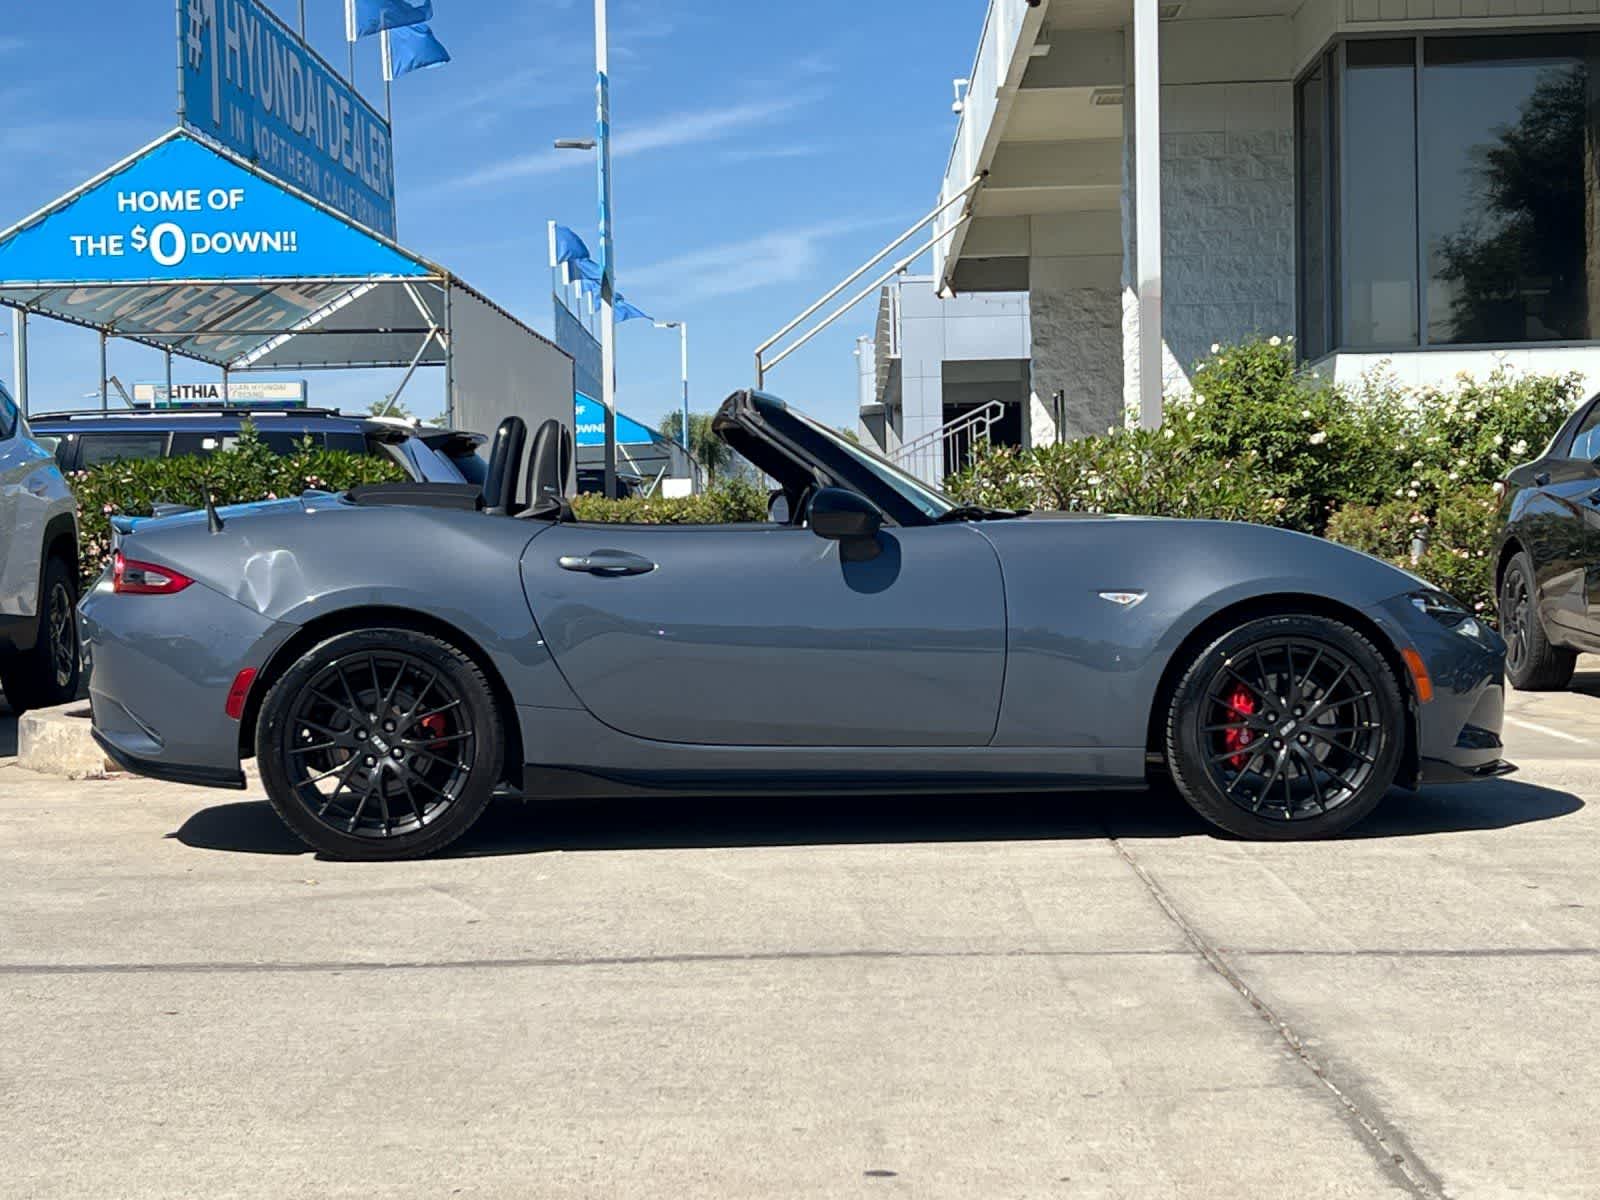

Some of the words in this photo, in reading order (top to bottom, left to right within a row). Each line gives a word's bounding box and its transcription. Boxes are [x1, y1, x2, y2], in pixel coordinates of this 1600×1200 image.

[187, 0, 220, 126] #1
[224, 0, 323, 151] HYUNDAI
[326, 84, 390, 200] DEALER
[229, 101, 245, 144] IN
[252, 116, 320, 196] NORTHERN
[117, 191, 201, 212] HOME
[207, 189, 245, 210] OF
[69, 235, 125, 257] THE
[191, 231, 297, 254] DOWN!!
